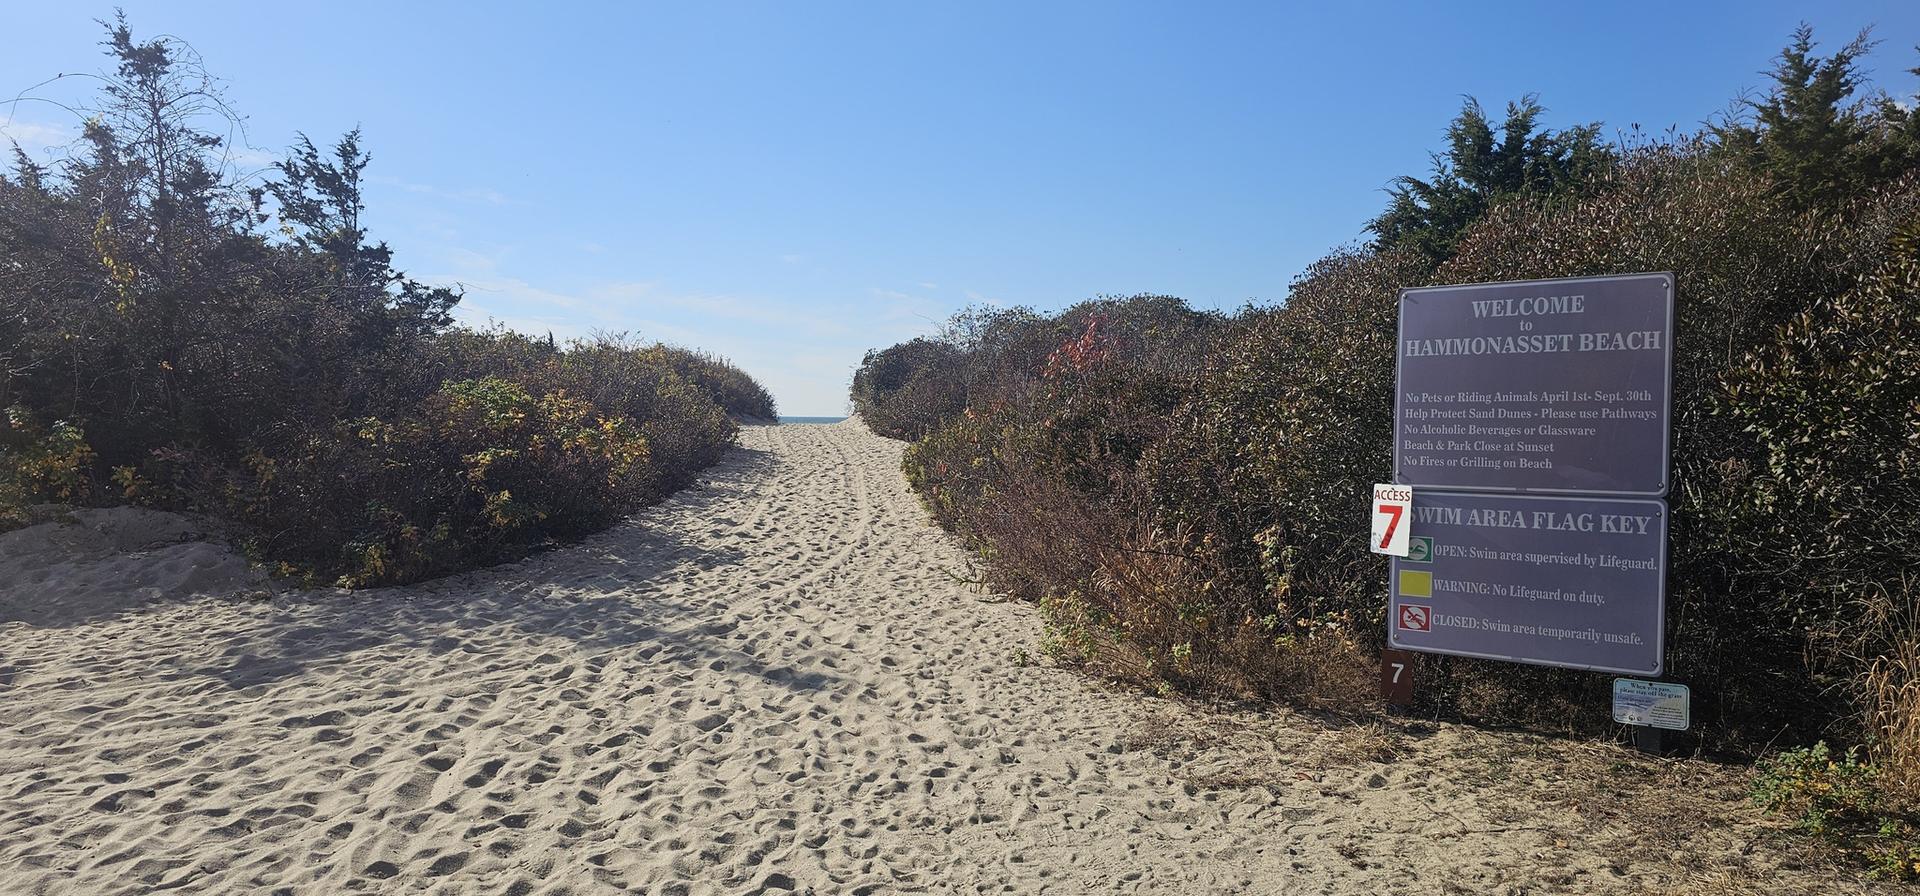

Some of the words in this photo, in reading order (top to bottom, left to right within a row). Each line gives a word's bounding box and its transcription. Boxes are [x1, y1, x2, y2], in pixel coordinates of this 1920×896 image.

[1472, 295, 1585, 318] WELCOME
[1520, 320, 1532, 331] to
[1405, 335, 1573, 356] HAMMONASSET
[1579, 331, 1661, 352] BEACH
[1405, 393, 1419, 402] No
[1422, 393, 1442, 402] Pets
[1458, 392, 1491, 405] Riding
[1494, 392, 1537, 402] Animals
[1540, 392, 1568, 405] April
[1595, 391, 1623, 404] Sept.
[1627, 391, 1651, 401] 30th
[1405, 408, 1427, 420] Help
[1431, 409, 1466, 419] Protect
[1469, 408, 1494, 419] Sand
[1498, 409, 1531, 419] Dunes
[1541, 408, 1576, 419] Please
[1580, 411, 1597, 419] use
[1602, 408, 1657, 420] Pathways
[1405, 425, 1418, 434] No
[1420, 425, 1466, 435] Alcoholic
[1469, 425, 1520, 437] Beverages
[1539, 425, 1596, 436] Glassware
[1404, 441, 1433, 450] Beach
[1436, 442, 1444, 450] &
[1447, 441, 1471, 451] Park
[1474, 442, 1501, 451] Close
[1504, 443, 1514, 451] at
[1517, 442, 1554, 452] Sunset
[1404, 456, 1417, 466] No
[1420, 457, 1444, 467] Fires
[1447, 459, 1458, 467] or
[1460, 457, 1500, 469] Grilling
[1504, 460, 1516, 468] on
[1520, 459, 1552, 469] Beach
[1374, 490, 1410, 502] ACCESS
[1379, 504, 1402, 548] 7
[1468, 510, 1526, 529] AREA
[1532, 512, 1594, 532] FLAG
[1600, 515, 1651, 535] KEY
[1435, 545, 1467, 558] OPEN:
[1470, 547, 1497, 559] Swim
[1500, 551, 1521, 561] area
[1525, 551, 1581, 565] supervised
[1584, 552, 1596, 568] by
[1600, 555, 1656, 571] Lifeguard.
[1434, 579, 1490, 594] WARNING:
[1493, 584, 1506, 596] No
[1510, 585, 1560, 601] Lifeguard
[1564, 591, 1576, 601] on
[1579, 590, 1604, 605] duty.
[1433, 615, 1480, 629] CLOSED:
[1482, 618, 1510, 632] Swim
[1513, 623, 1535, 634] area
[1538, 624, 1601, 640] temporarily
[1604, 630, 1643, 645] unsafe.
[1391, 663, 1404, 684] 7
